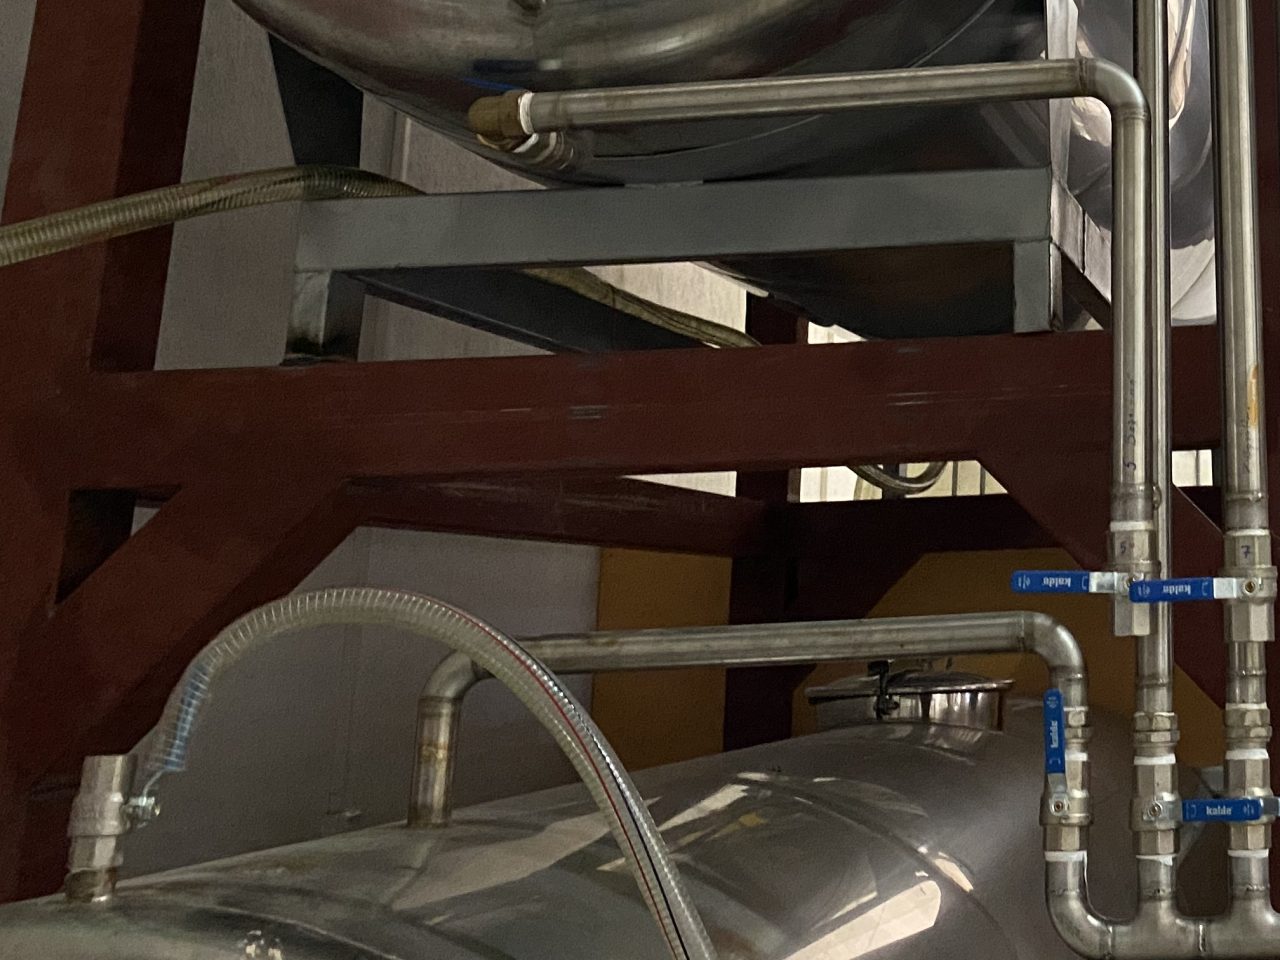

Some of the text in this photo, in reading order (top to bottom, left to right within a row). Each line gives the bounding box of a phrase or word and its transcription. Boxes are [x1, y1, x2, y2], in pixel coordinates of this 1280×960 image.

[1240, 544, 1251, 558] 7
[1050, 720, 1059, 749] kalde
[1206, 805, 1233, 816] kalde
